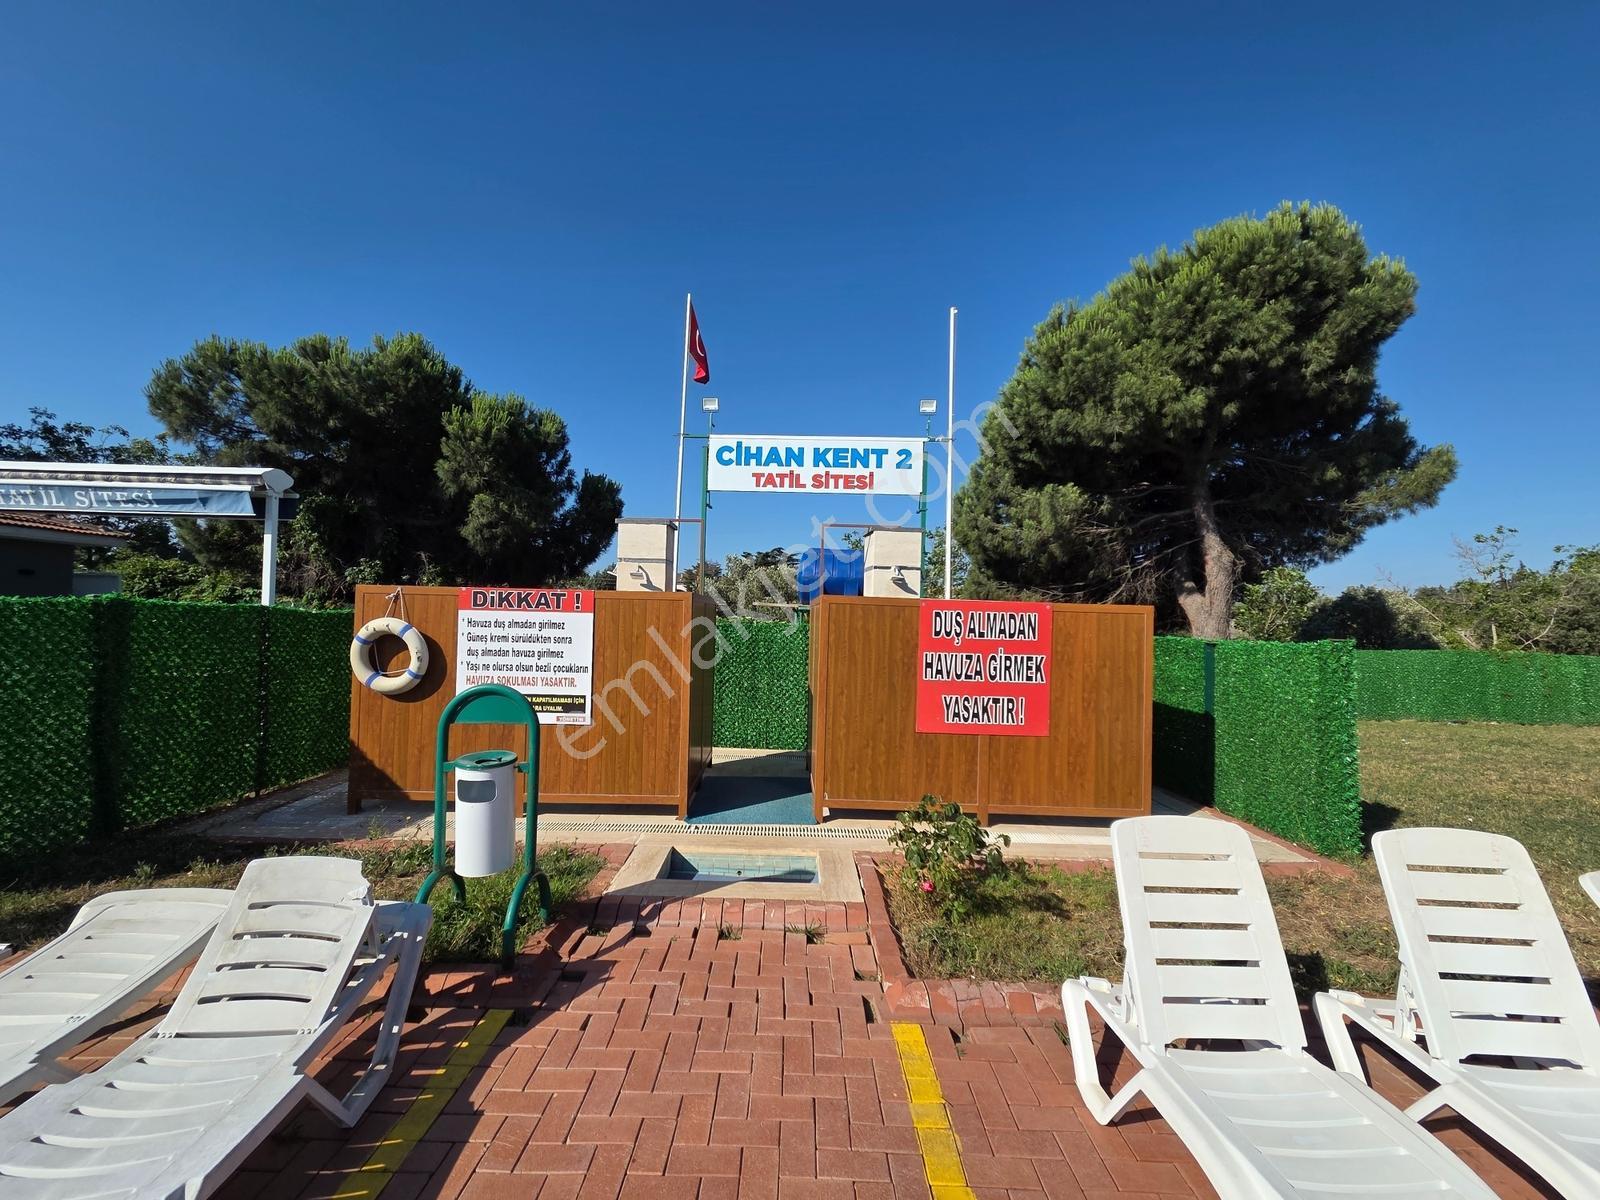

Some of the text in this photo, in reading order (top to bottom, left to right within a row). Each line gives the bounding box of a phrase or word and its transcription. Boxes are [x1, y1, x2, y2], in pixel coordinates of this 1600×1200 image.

[716, 441, 912, 470] CİHAN KENT 2
[752, 470, 874, 490] TATİL SİTESİ
[74, 488, 160, 508] SİTESİ
[574, 593, 582, 610] !
[467, 618, 565, 632] Havuza duş almadan girilmez
[932, 610, 1038, 646] DUŞ ALMADAN
[466, 632, 572, 644] Güneş kremi sürüldükten sonra
[467, 647, 564, 660] duş almadan havuza girilmez
[466, 661, 588, 675] Yaşı ne olursa olsun bezli çocukların
[923, 648, 1046, 683] HAVUZA GİRMEK
[466, 676, 577, 688] HAVUZA SOKULMASI YASAKTIR.
